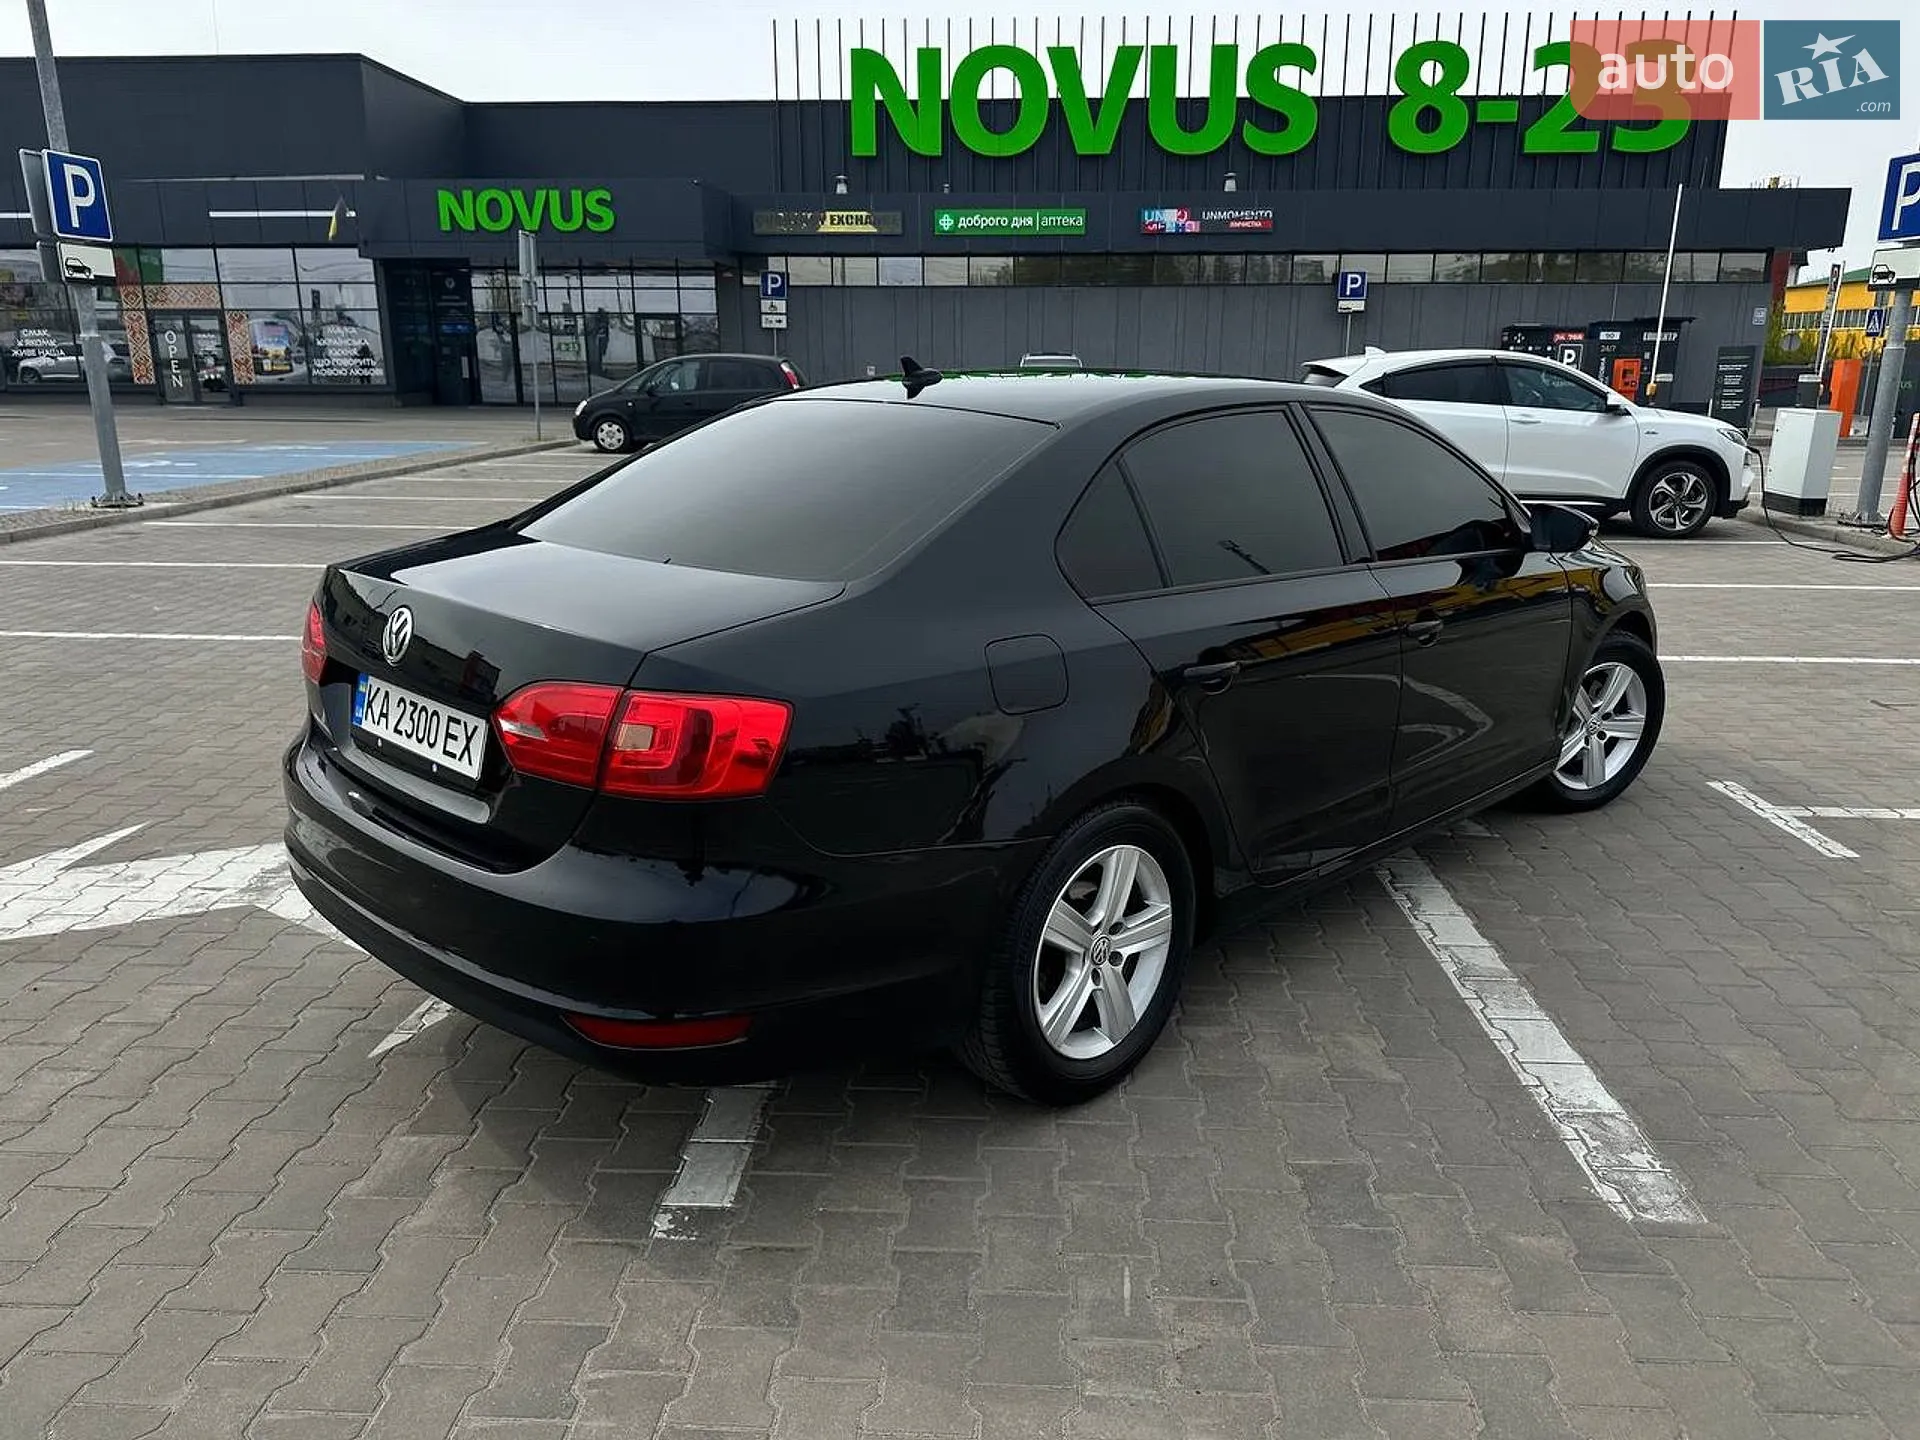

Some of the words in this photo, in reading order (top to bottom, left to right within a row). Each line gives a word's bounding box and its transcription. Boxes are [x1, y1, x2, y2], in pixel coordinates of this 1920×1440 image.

[850, 45, 1318, 157] NOVUS
[1387, 40, 1692, 155] 8-23
[63, 163, 96, 229] P
[437, 187, 616, 231] NOVUS
[1202, 209, 1273, 220] UNMOMENTO
[957, 213, 1009, 229] доброго
[1010, 215, 1033, 229] дня
[1041, 215, 1083, 227] аптека
[768, 273, 782, 296] P
[1346, 273, 1362, 296] P
[164, 330, 184, 388] OPEN
[364, 683, 391, 732] KA
[393, 696, 441, 749] 2300
[442, 714, 479, 767] EX
